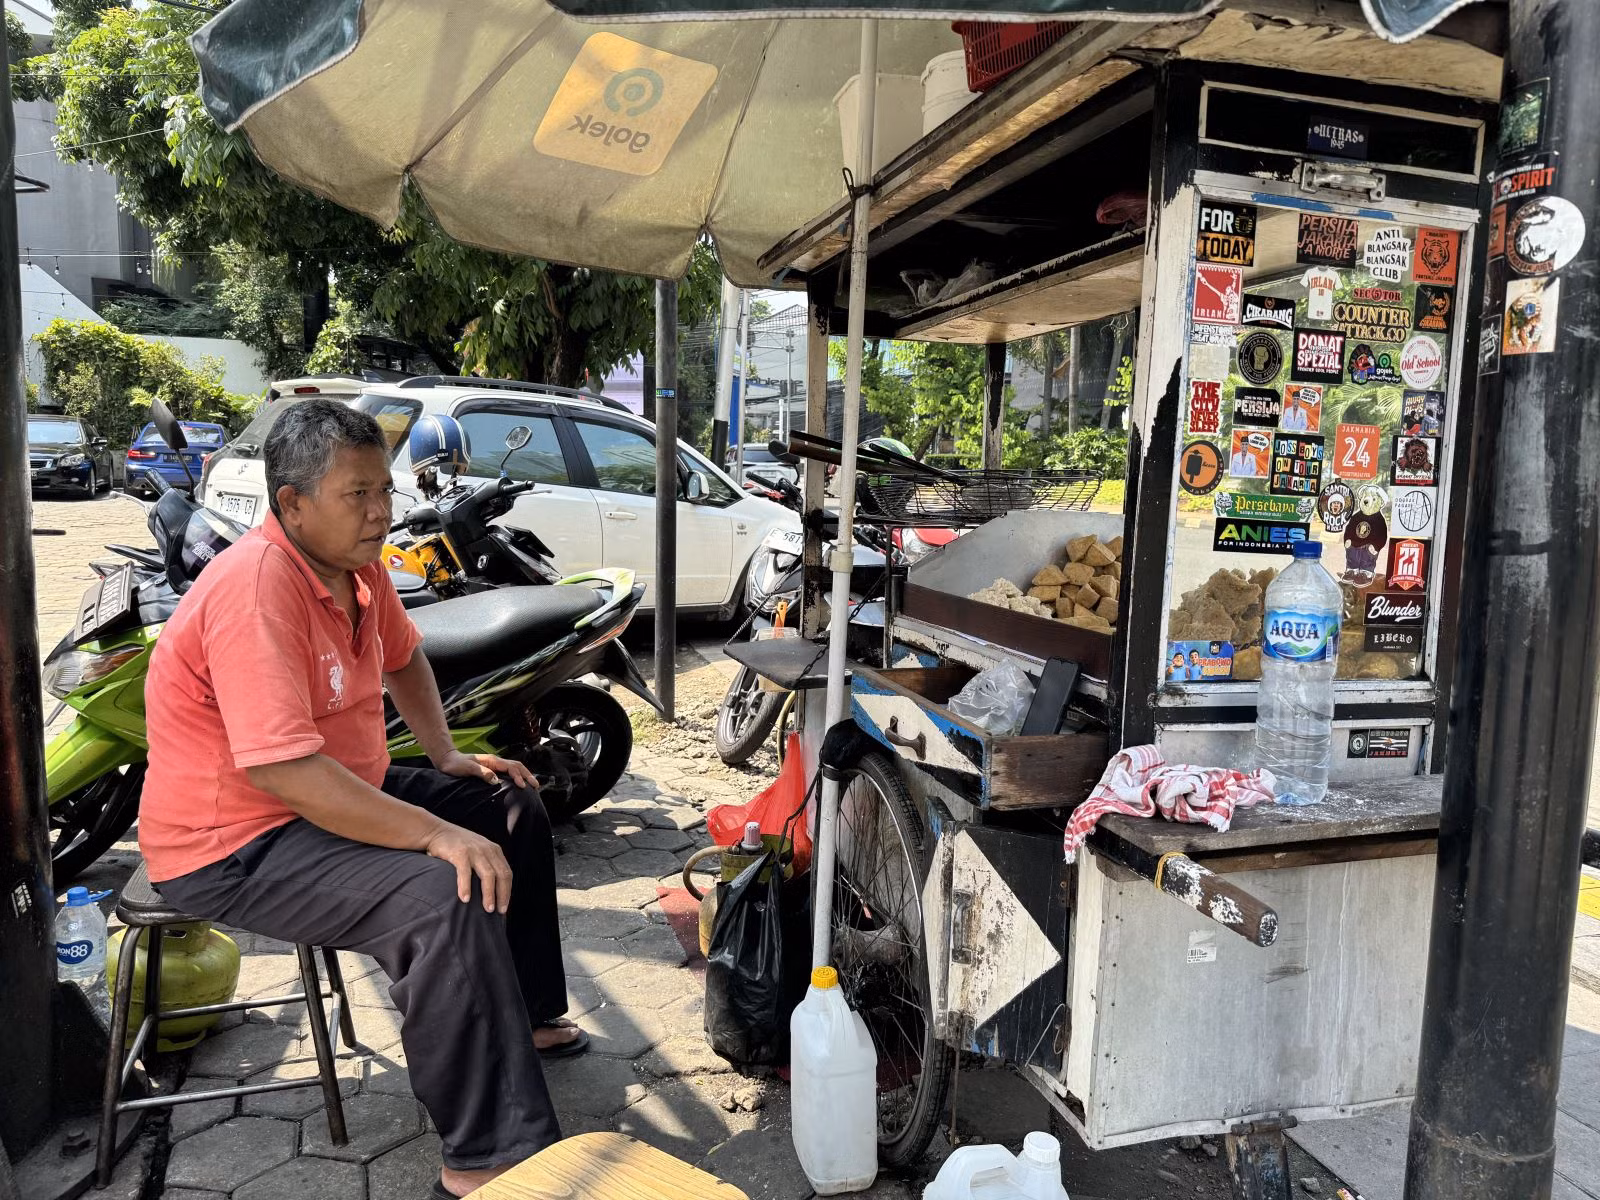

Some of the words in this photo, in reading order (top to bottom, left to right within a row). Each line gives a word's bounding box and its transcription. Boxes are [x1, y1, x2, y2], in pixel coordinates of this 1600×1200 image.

[1319, 124, 1359, 143] ULTRAS
[1510, 168, 1555, 192] SPIRIT
[1200, 207, 1234, 233] FOR
[1300, 214, 1359, 237] PERSIJA
[1297, 230, 1357, 250] JAKARTA
[1375, 229, 1400, 241] ANTI
[1200, 236, 1250, 260] TODAY
[1367, 241, 1408, 253] BLANGSAK
[1366, 254, 1407, 268] BLANGSAK
[1372, 267, 1399, 280] CLUB
[1245, 303, 1293, 325] CIKARANG
[1334, 302, 1410, 327] COUNTER
[1298, 333, 1344, 353] DONAT
[1297, 350, 1342, 369] SPEZIAL
[1401, 358, 1415, 371] Old
[1417, 354, 1440, 369] School
[1192, 381, 1220, 399] THE
[1191, 397, 1220, 412] CITY
[1234, 399, 1280, 415] PERSIJA
[1190, 410, 1219, 422] NEVER
[1190, 420, 1219, 433] SLEEP
[1341, 425, 1376, 434] JAKMANIA
[1275, 440, 1297, 456] JOSS
[1299, 442, 1323, 460] BOYS
[1342, 437, 1370, 468] 24
[1276, 458, 1291, 472] ON
[1295, 460, 1319, 475] TOUR
[1273, 475, 1317, 492] JAKARTA
[1325, 485, 1351, 496] SANTRI
[1235, 496, 1295, 513] Persebaya
[1323, 511, 1348, 526] ROCK
[1218, 523, 1306, 543] ANIES
[1367, 595, 1422, 622] Blunder
[1270, 619, 1320, 642] AQUA
[1373, 632, 1413, 644] LIBERO
